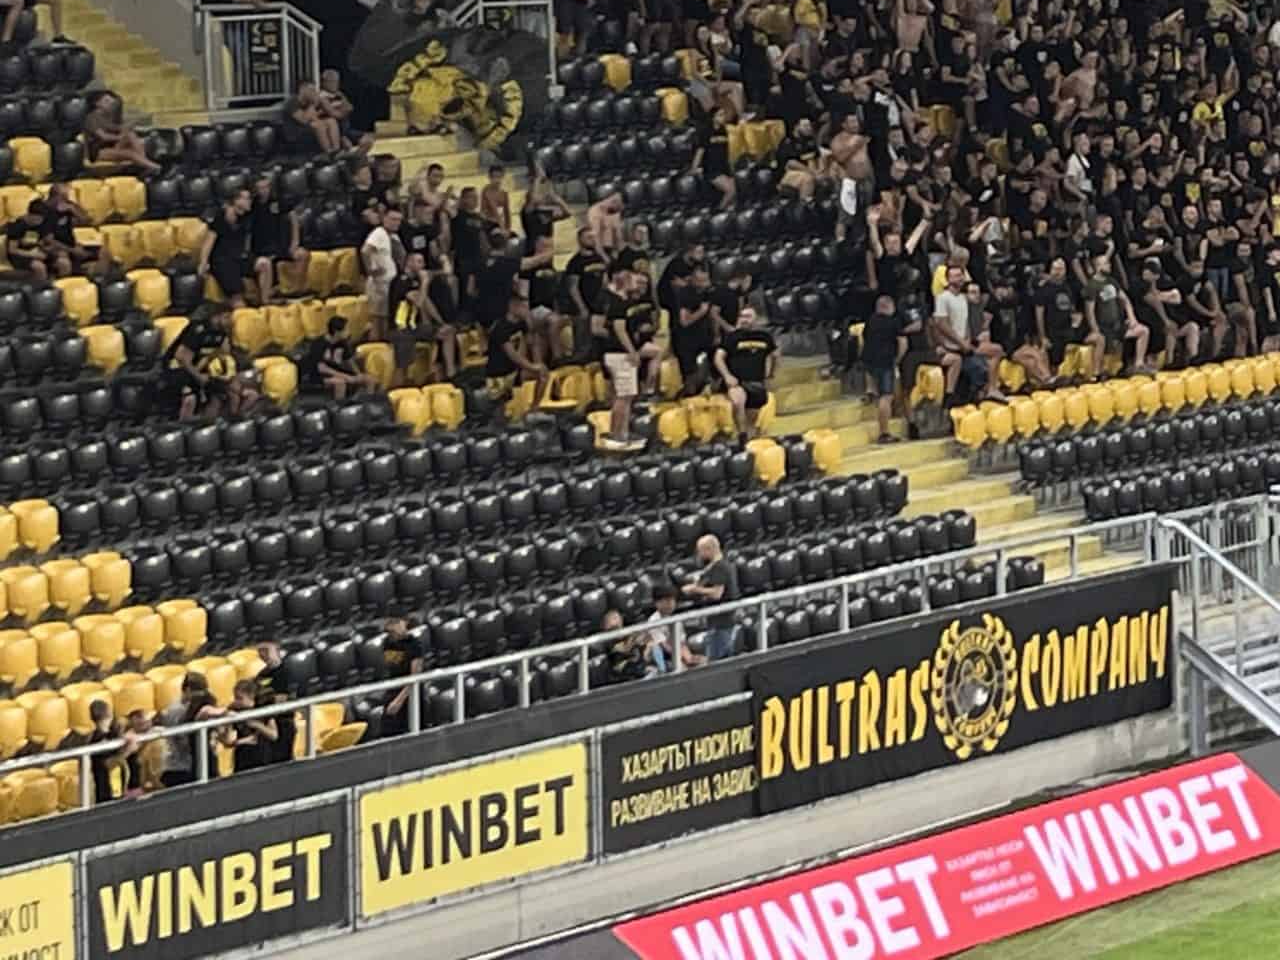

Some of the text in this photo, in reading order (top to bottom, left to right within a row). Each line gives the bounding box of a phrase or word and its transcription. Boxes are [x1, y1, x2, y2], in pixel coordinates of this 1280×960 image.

[761, 605, 1169, 780] BULTRAS COMPANY
[610, 781, 690, 828] РАЗВИВАНЕ
[692, 776, 712, 807] НА
[622, 740, 692, 784] ХАЗАРТЪТ
[373, 775, 574, 882] WINBET
[1023, 763, 1261, 901] WINBET
[19, 900, 41, 932] ОТ
[100, 833, 333, 952] WINBET
[672, 855, 950, 960] WINBET
